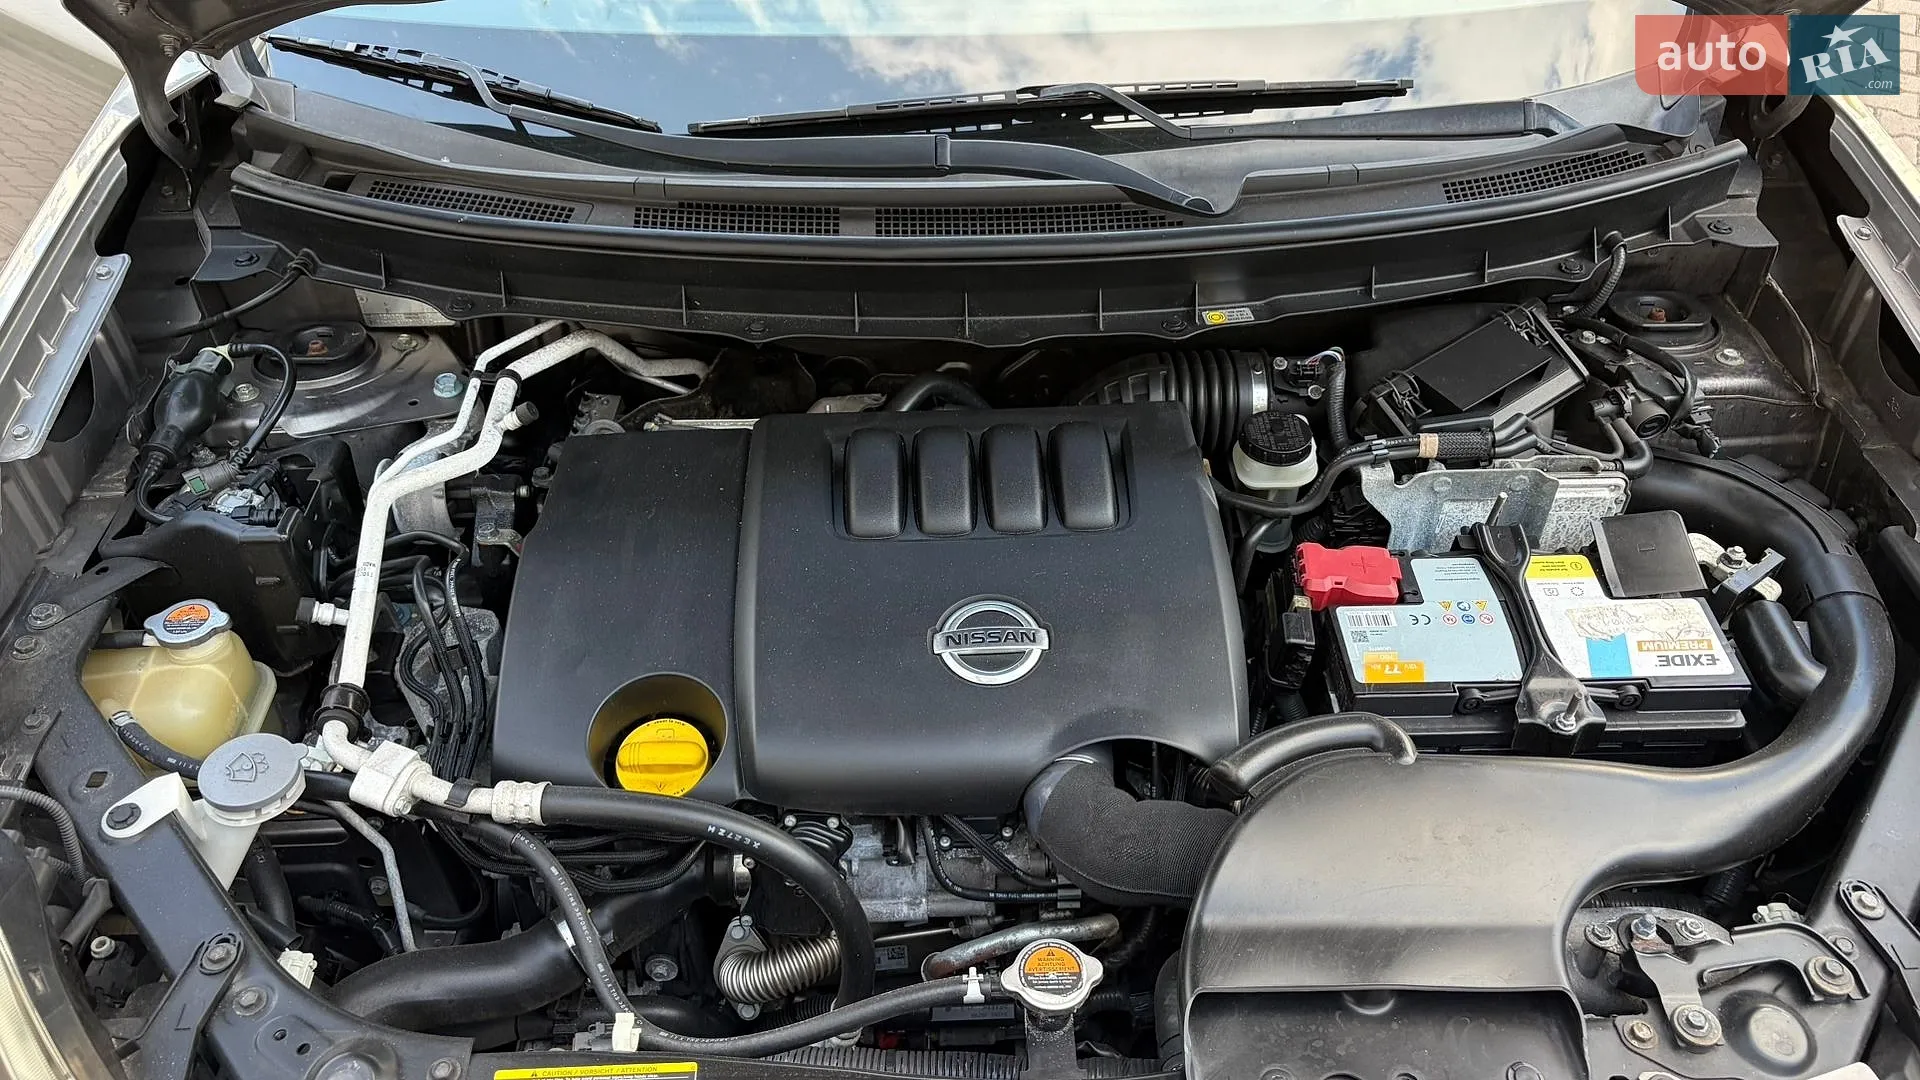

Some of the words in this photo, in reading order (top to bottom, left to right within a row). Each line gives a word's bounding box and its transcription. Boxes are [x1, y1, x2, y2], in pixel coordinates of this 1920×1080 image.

[945, 630, 1037, 647] NISSAN
[1641, 640, 1709, 651] PREMIUM
[1656, 653, 1721, 667] EXIDE
[1383, 663, 1403, 675] 77
